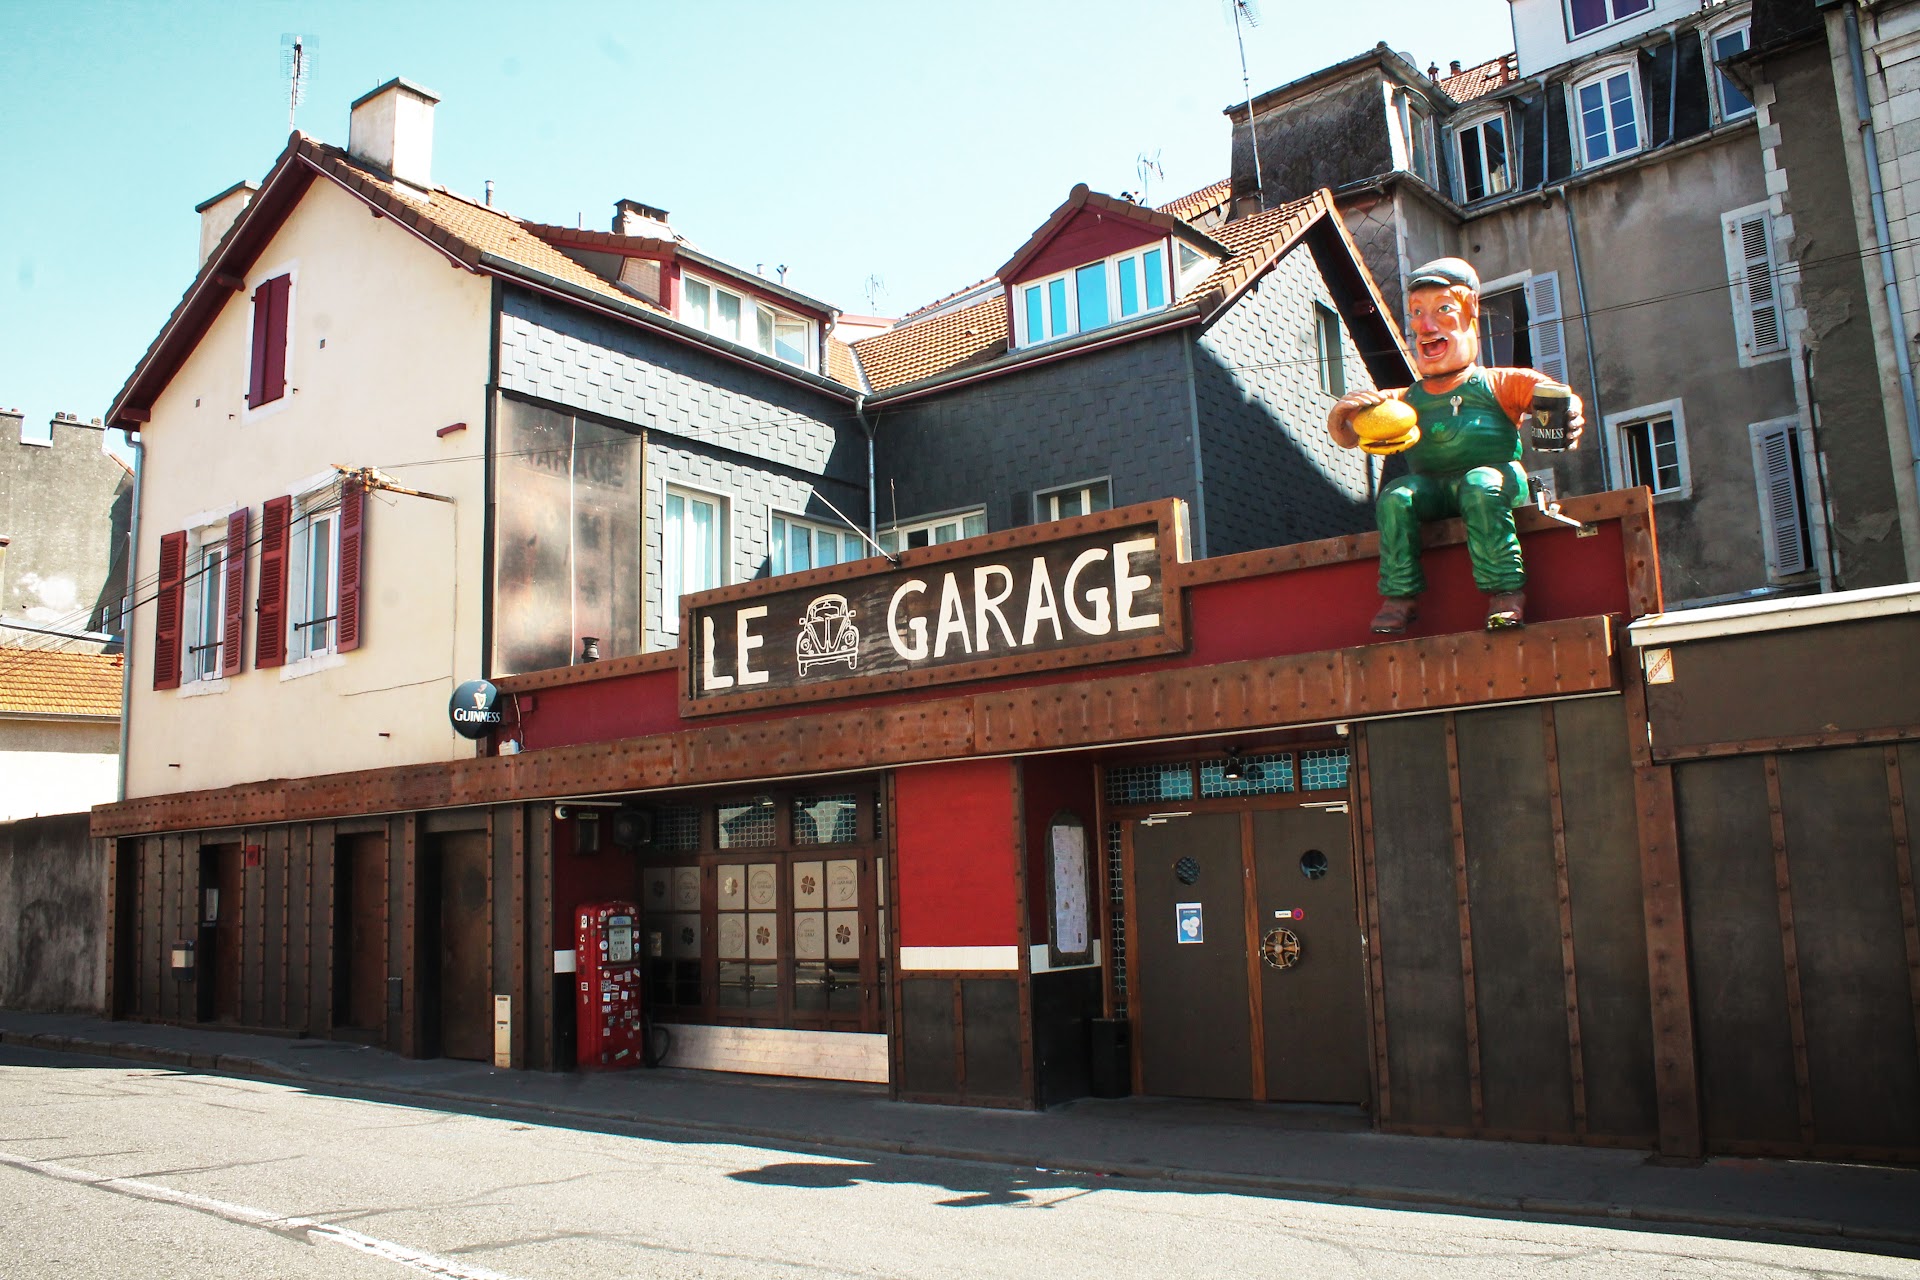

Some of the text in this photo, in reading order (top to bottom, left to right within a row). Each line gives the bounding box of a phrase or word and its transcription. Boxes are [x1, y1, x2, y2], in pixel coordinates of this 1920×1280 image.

[703, 537, 1160, 691] LE GARAGE
[454, 708, 501, 722] GUINNESS
